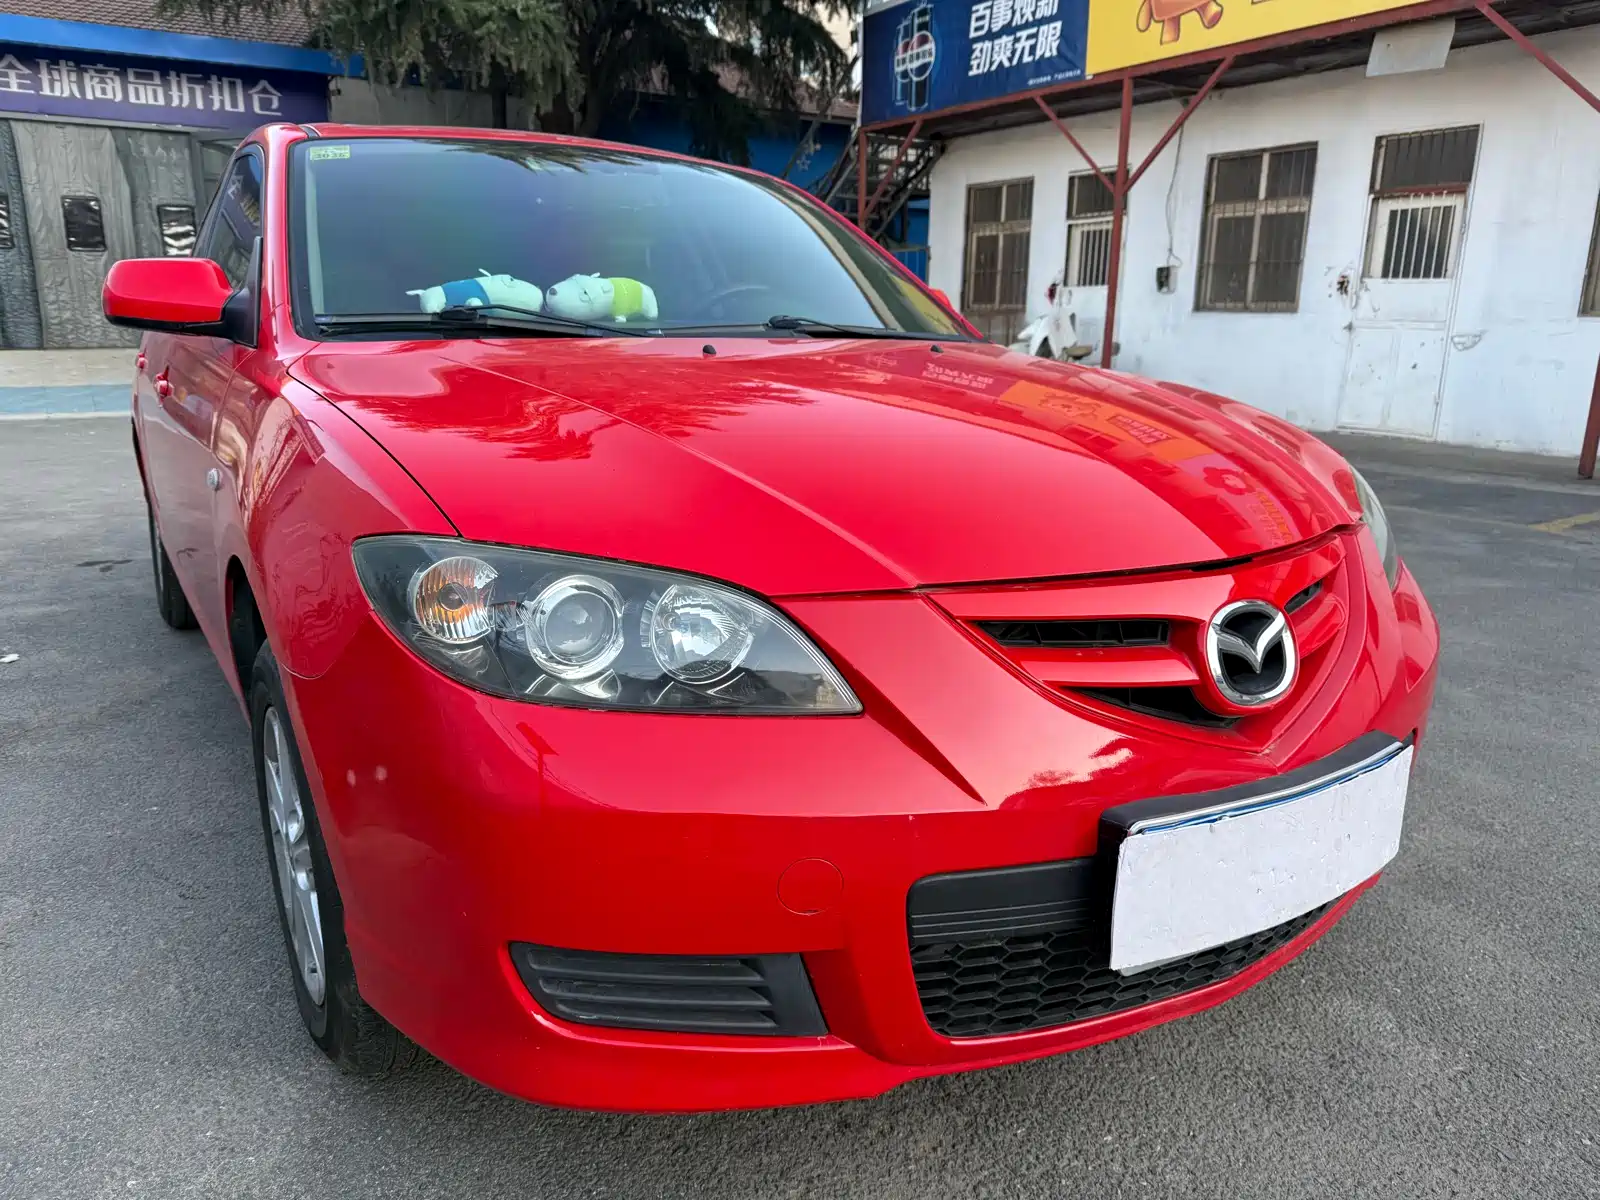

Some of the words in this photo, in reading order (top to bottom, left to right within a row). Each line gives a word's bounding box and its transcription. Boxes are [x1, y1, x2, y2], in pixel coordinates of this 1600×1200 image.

[968, 20, 1063, 77] 劲爽无限
[0, 53, 283, 116] 全球商品折扣仓
